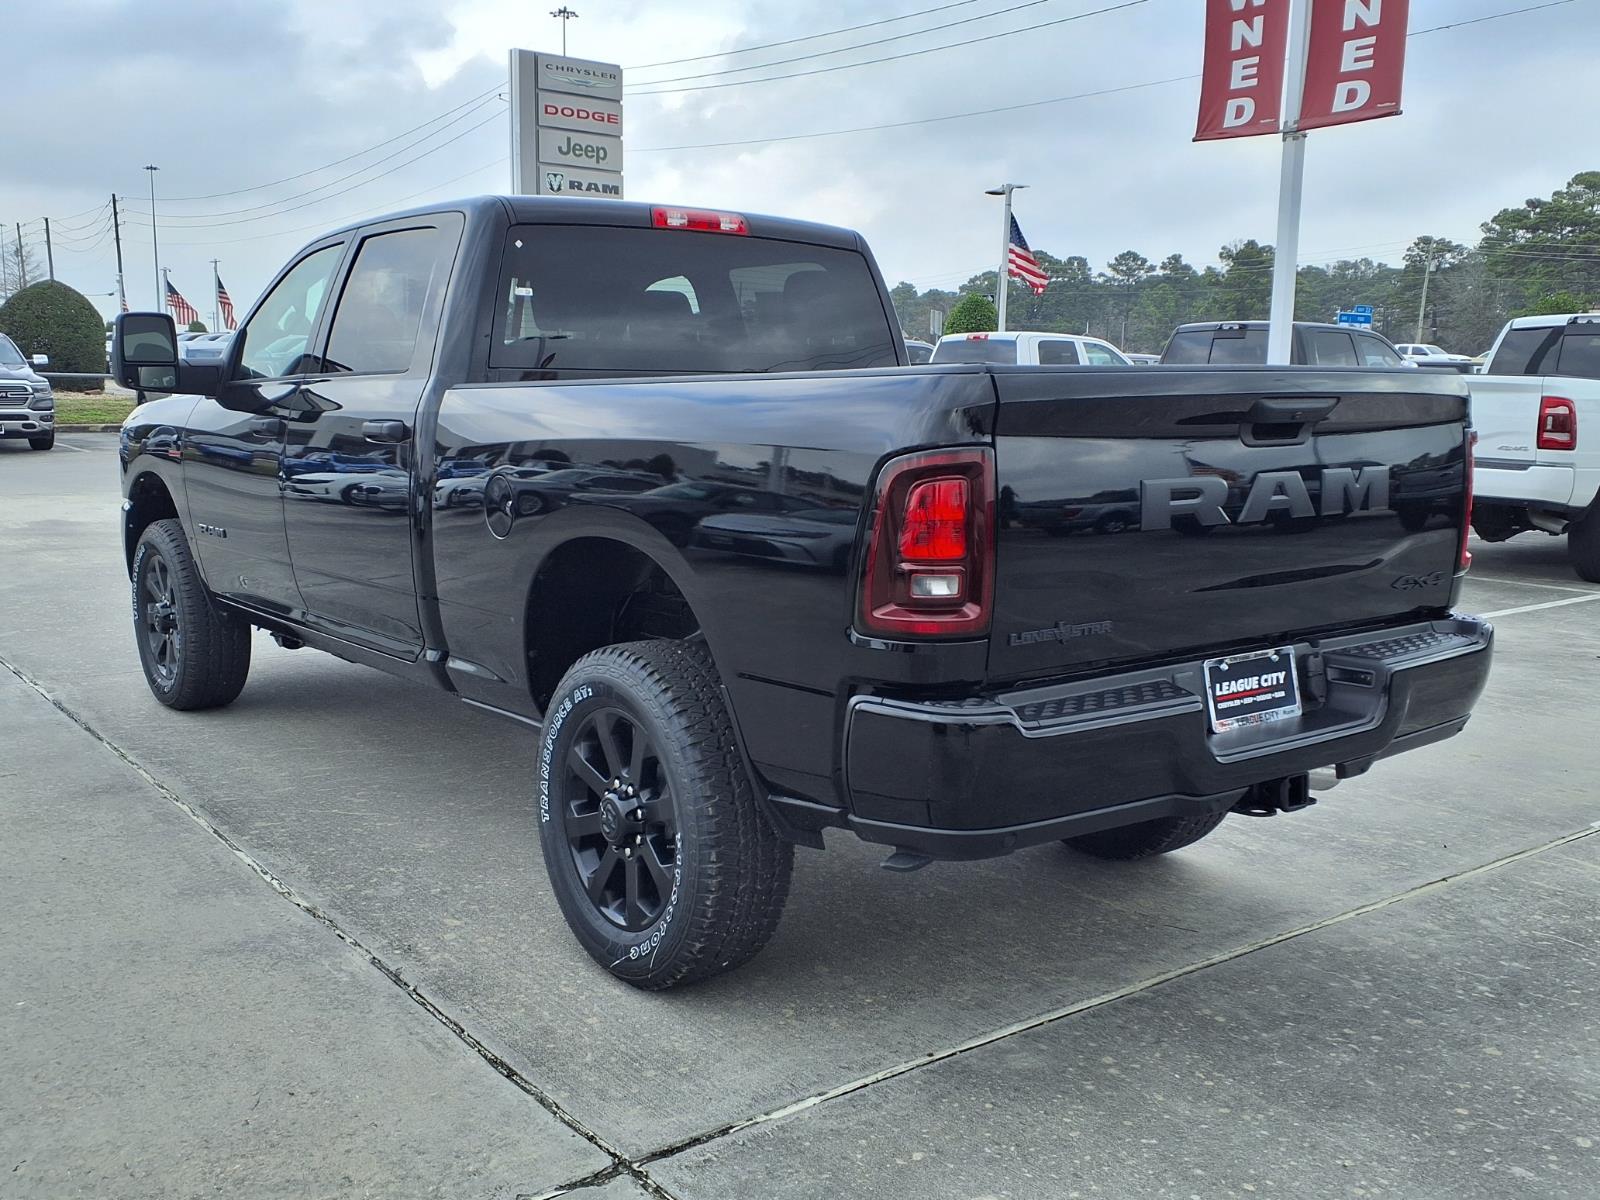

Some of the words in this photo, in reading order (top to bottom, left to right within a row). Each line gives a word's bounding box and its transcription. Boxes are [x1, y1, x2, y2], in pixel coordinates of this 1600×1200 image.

[545, 63, 617, 80] CHRYSLER
[544, 104, 619, 124] DODGE
[557, 136, 608, 164] Jeep
[568, 179, 620, 196] RAM
[1140, 465, 1391, 532] RAM
[1007, 627, 1058, 647] LONE
[1063, 620, 1113, 638] STAR
[1215, 676, 1260, 696] LEAGUE
[1260, 671, 1287, 688] CITY
[537, 696, 573, 823] TRANSFORCE
